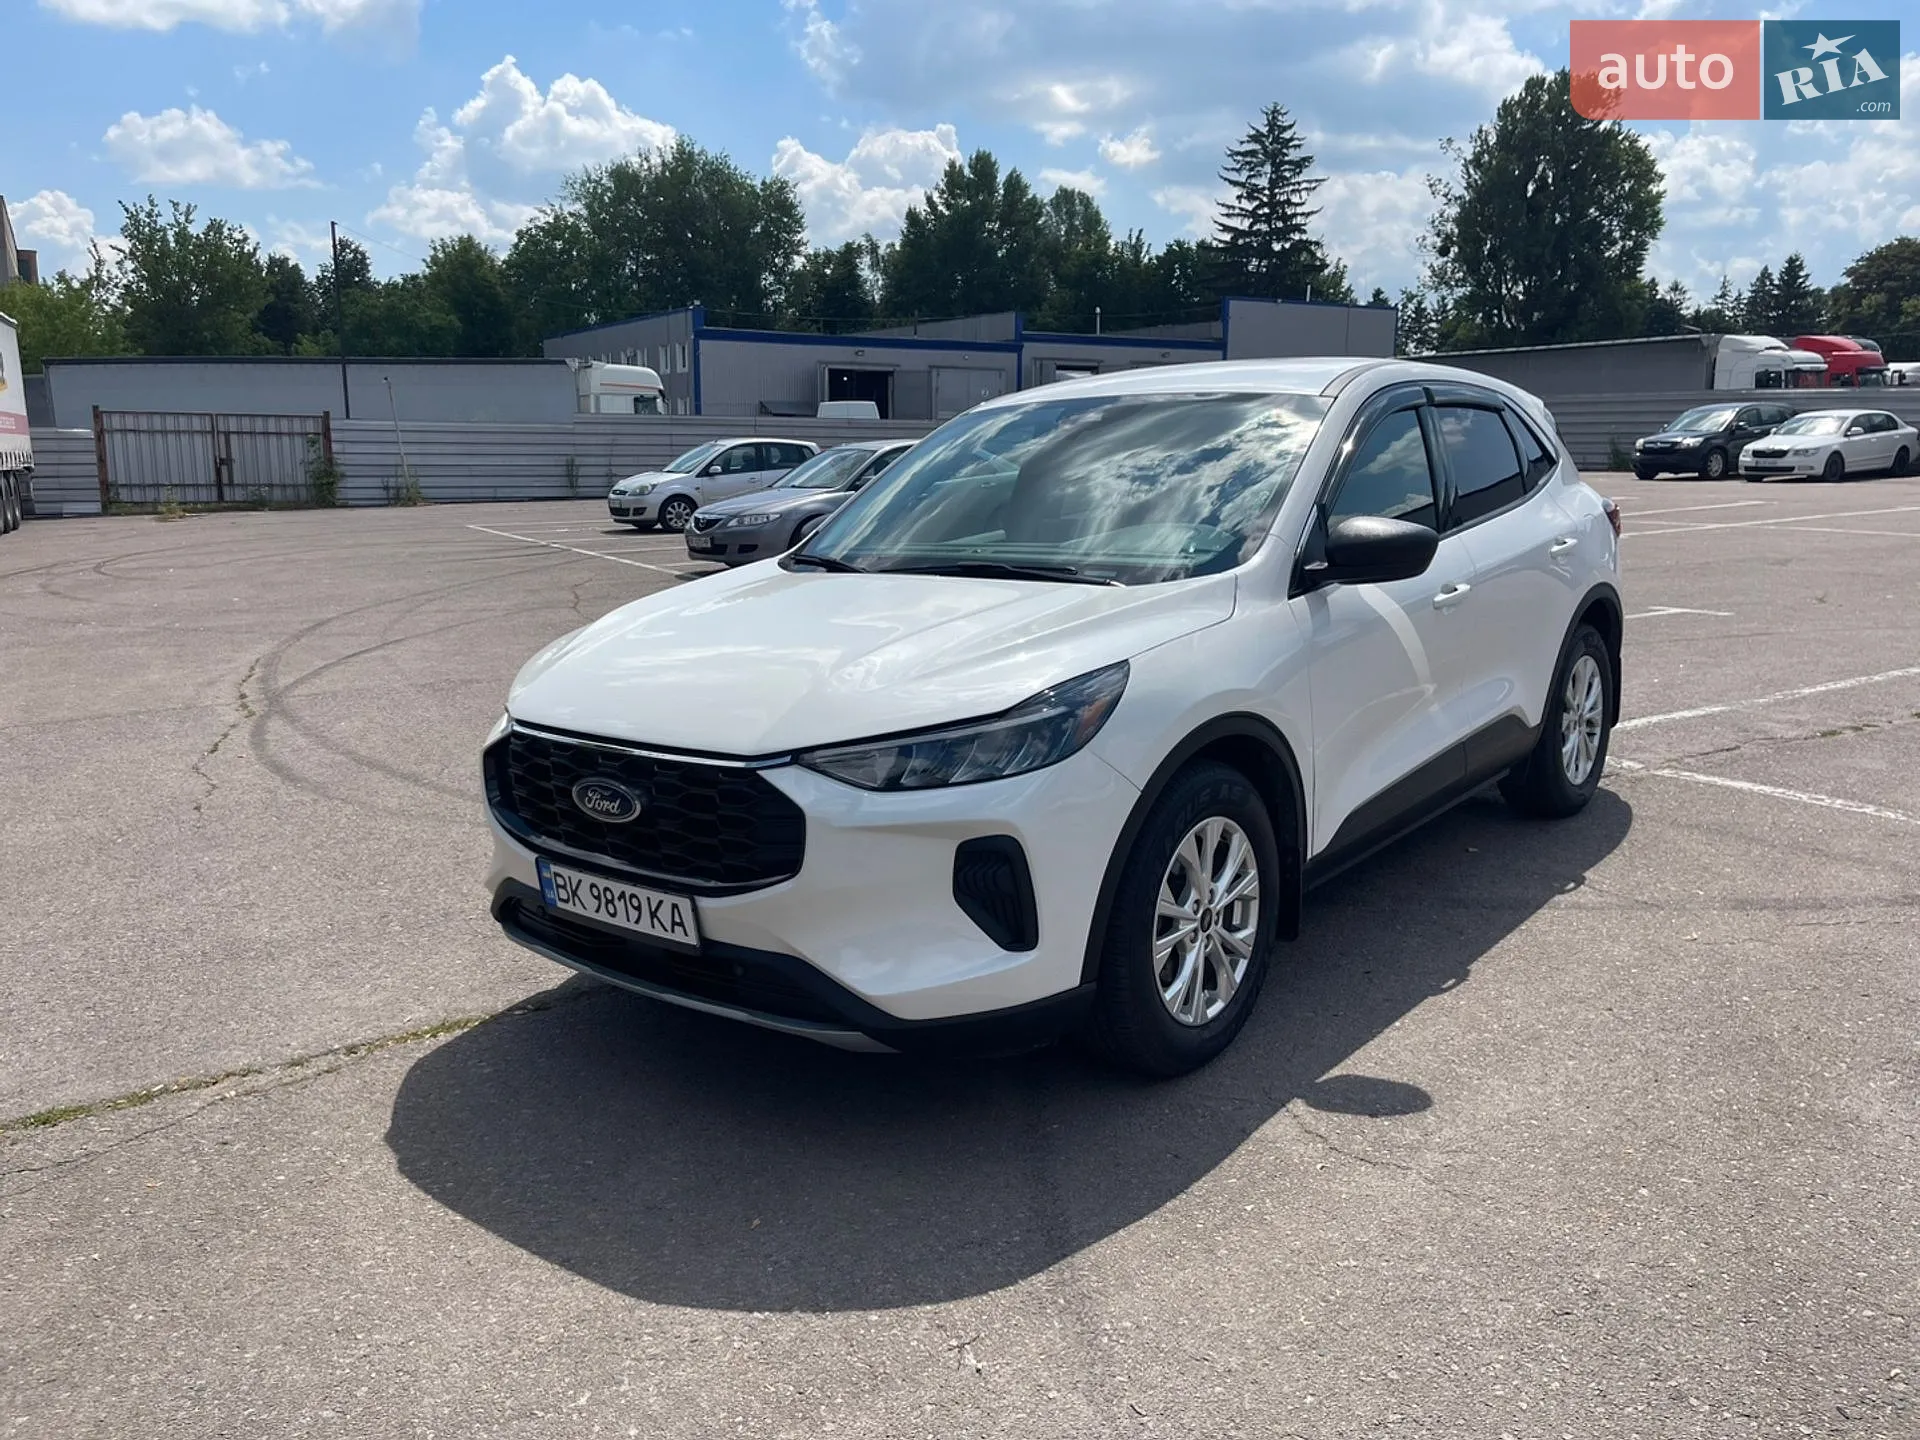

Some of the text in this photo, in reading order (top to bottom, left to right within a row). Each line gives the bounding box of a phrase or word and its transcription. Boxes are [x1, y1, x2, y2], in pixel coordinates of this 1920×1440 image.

[585, 787, 620, 814] Ford
[553, 871, 689, 937] BK 9819 KA
